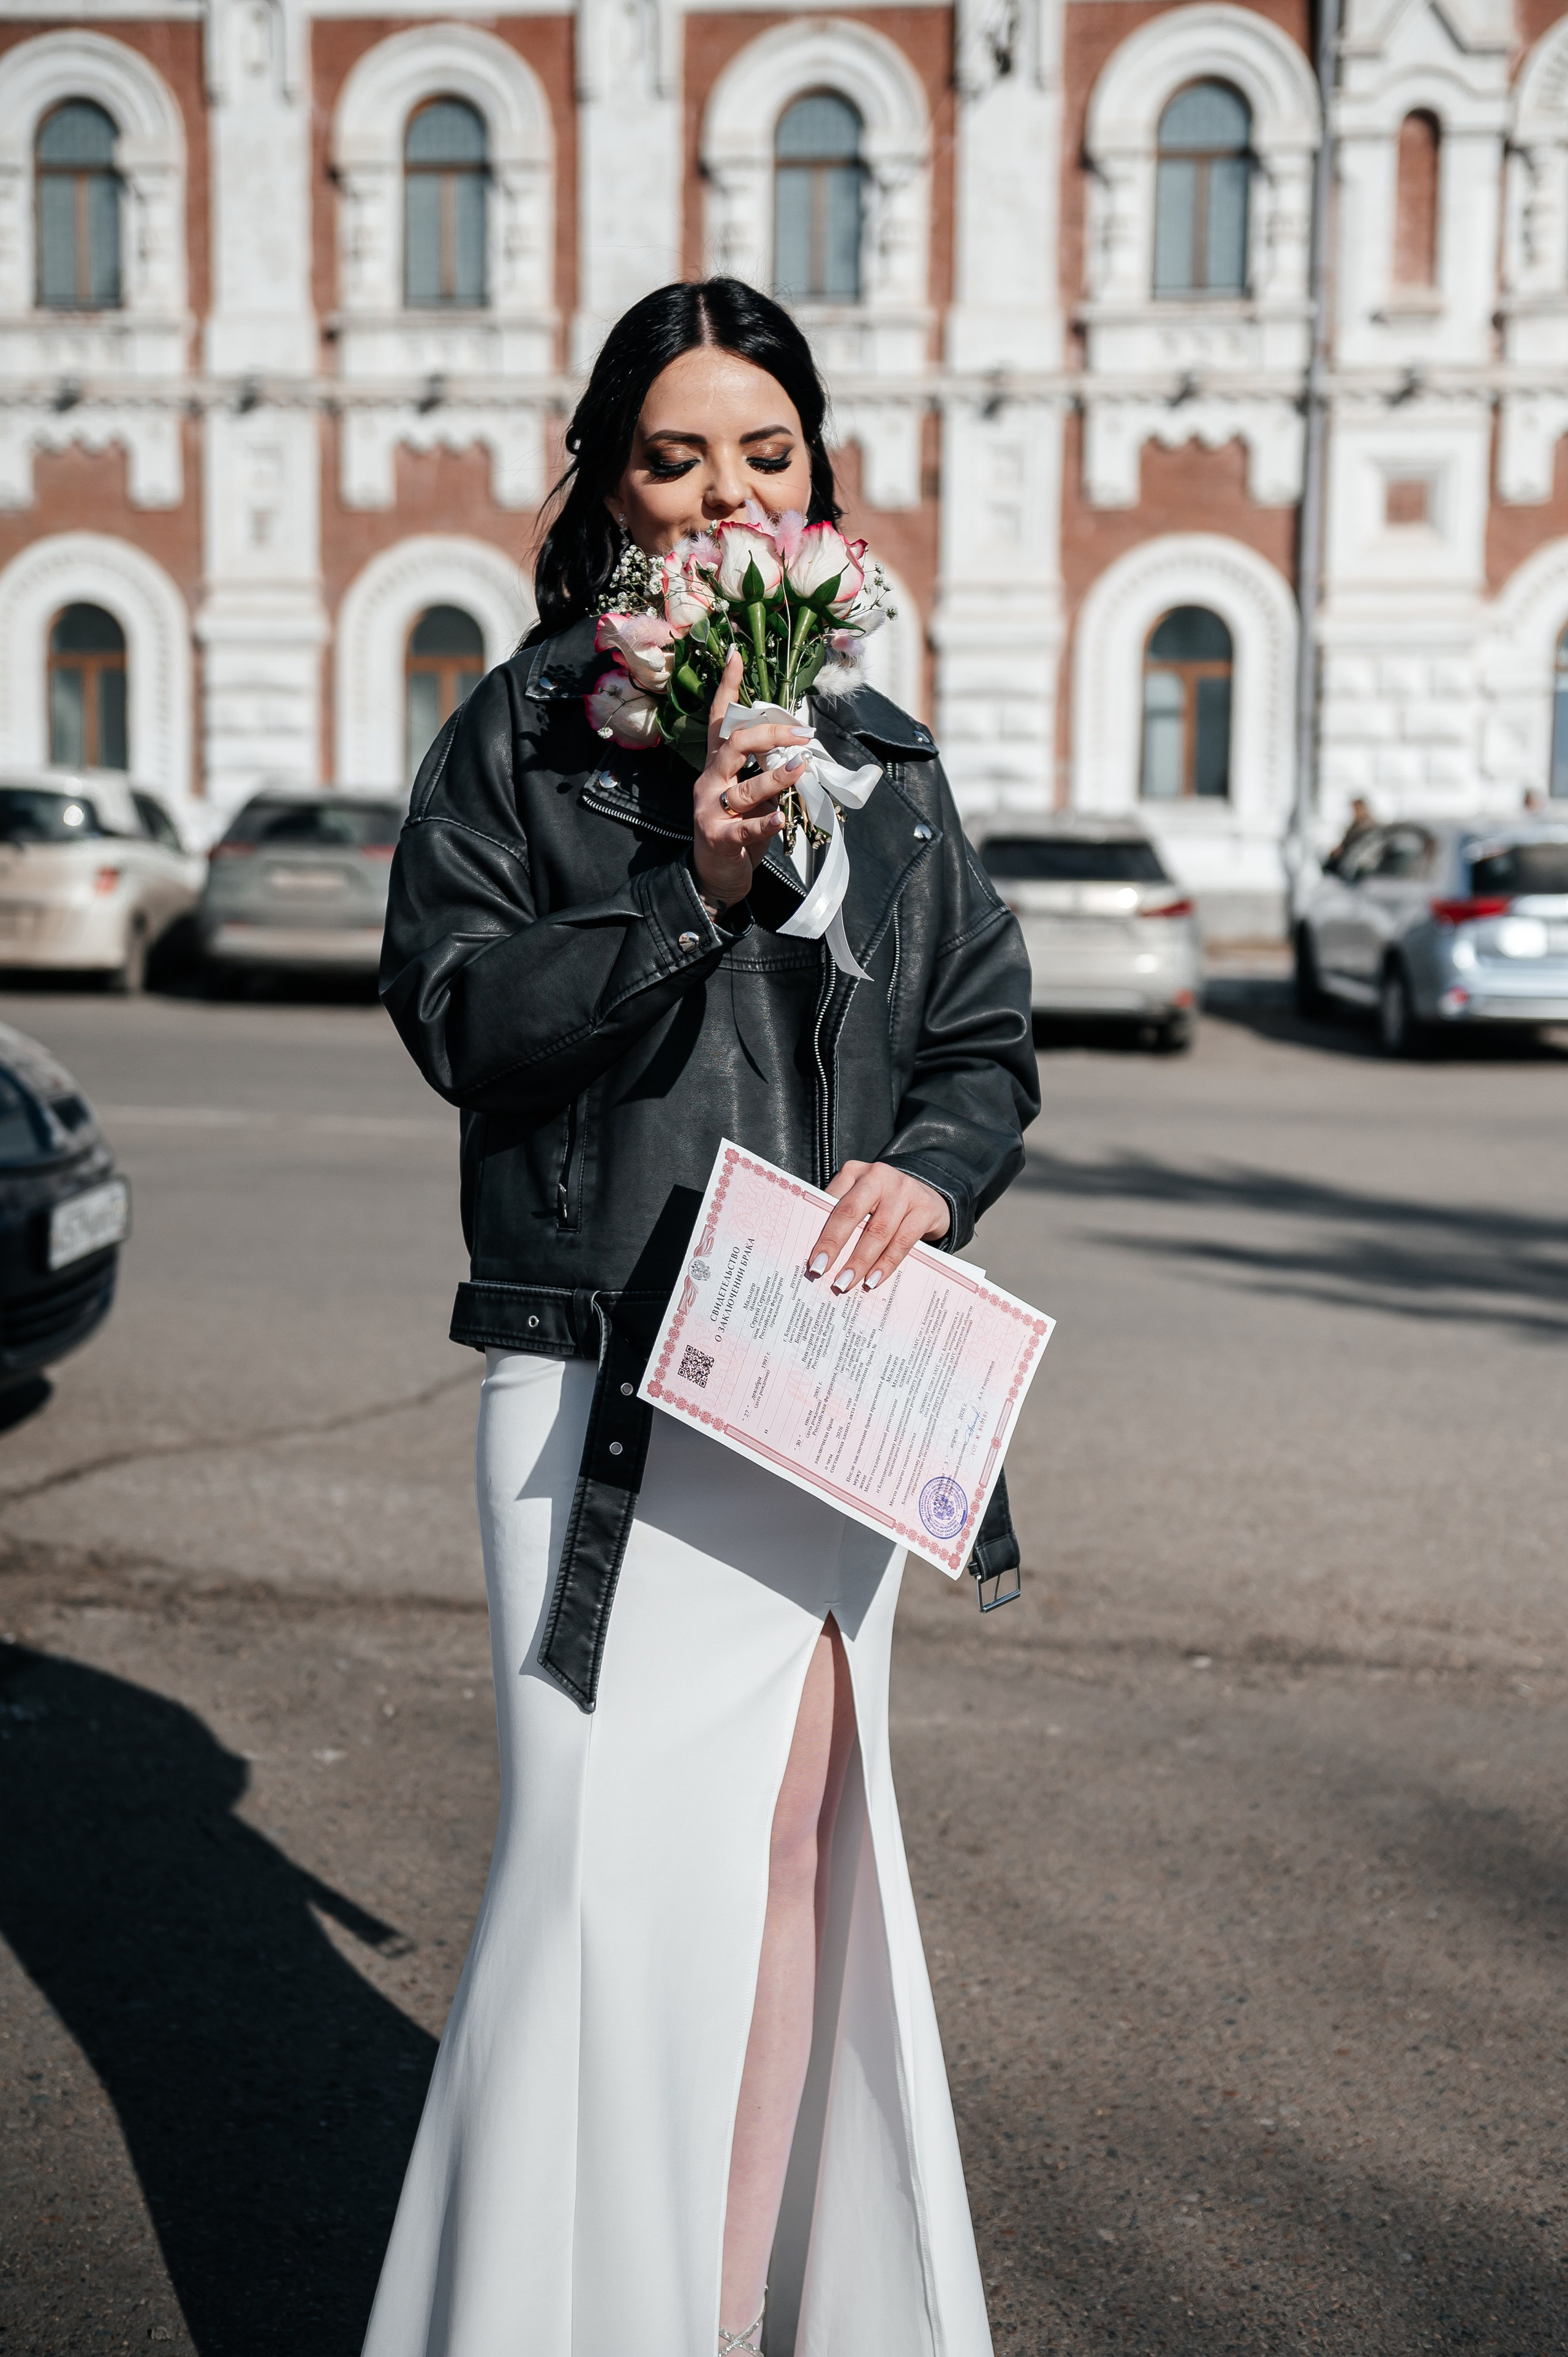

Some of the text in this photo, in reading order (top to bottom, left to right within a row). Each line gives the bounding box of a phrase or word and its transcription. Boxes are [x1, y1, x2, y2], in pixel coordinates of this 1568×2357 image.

[709, 1246, 740, 1322] СВИДЕТЕЛЬСТВО
[714, 1237, 755, 1343] О ЗАКЛЮЧЕНИИ БРАКА
[742, 1282, 756, 1311] Мальцев
[789, 1264, 801, 1289] русский
[748, 1286, 761, 1311] (фамилия)
[748, 1275, 772, 1329] Сергей Сергеевич
[752, 1327, 761, 1340] (имя,
[757, 1305, 767, 1327] отчество
[768, 1270, 780, 1294] наличии)
[758, 1276, 784, 1340] Российская Федерация
[768, 1293, 785, 1328] (гражданство)
[783, 1297, 802, 1338] Благовещенск
[840, 1295, 851, 1319] русская
[921, 1289, 938, 1326] Благовещенск
[787, 1301, 806, 1344] (место рождения)
[793, 1307, 810, 1344] Бондаренко
[801, 1316, 813, 1341] (фамилия)
[801, 1302, 826, 1363] Виктория Сергеевна
[810, 1306, 836, 1370] Российская Федерация
[821, 1323, 836, 1358] (гражданство)
[911, 1336, 920, 1351] ЗАГС
[917, 1329, 924, 1338] по
[810, 1335, 820, 1357] отчество
[839, 1331, 857, 1373] (место рождения)
[846, 1347, 858, 1368] апреля
[853, 1333, 862, 1348] 2026
[907, 1349, 916, 1365] отдел
[930, 1394, 941, 1413] округу
[937, 1363, 952, 1397] управления
[953, 1326, 966, 1352] Амурской
[963, 1305, 973, 1327] области
[743, 1409, 750, 1418] 27
[750, 1376, 762, 1401] декабря
[760, 1354, 769, 1369] 1997
[753, 1368, 771, 1409] (дата рождения)
[811, 1403, 827, 1436] Российская
[823, 1371, 838, 1403] Федерация,
[833, 1338, 848, 1371] Республика
[845, 1324, 853, 1338] Саха
[849, 1299, 863, 1325] (Якутия),
[876, 1441, 897, 1489] Благовещенскому
[907, 1378, 918, 1397] округу
[913, 1347, 929, 1379] управления
[924, 1333, 933, 1348] ЗАГС
[929, 1308, 943, 1335] Амурской
[939, 1288, 950, 1310] области
[898, 1365, 910, 1389] 92800001
[980, 1360, 995, 1390] Ращупкина
[795, 1438, 802, 1447] 30
[804, 1409, 813, 1426] июля
[812, 1385, 821, 1399] 2001
[825, 1453, 834, 1465] чем
[834, 1425, 843, 1439] 2026
[854, 1361, 864, 1382] апреля
[865, 1328, 876, 1349] месяца
[829, 1441, 845, 1473] составлена
[841, 1420, 851, 1441] запись
[854, 1367, 869, 1403] заключении
[865, 1349, 875, 1367] брака
[845, 1352, 893, 1482] После заключения брака присвоены фамилии:
[884, 1398, 899, 1433] регистрации
[888, 1490, 898, 1507] Место
[902, 1431, 917, 1470] свидетельства
[918, 1391, 930, 1415] 92800001
[927, 1376, 936, 1392] отдел
[932, 1362, 941, 1377] ЗАГС
[938, 1355, 944, 1364] по
[941, 1314, 959, 1352] Благовещенск
[804, 1398, 823, 1439] (дата рождения)
[852, 1356, 899, 1487] мужу Мальцев
[858, 1357, 906, 1490] жене Мальцева
[949, 1428, 959, 1449] апреля
[957, 1406, 966, 1420] 2026
[813, 1416, 835, 1465] заключили брак
[870, 1431, 888, 1476] государственной
[863, 1476, 873, 1493] Место
